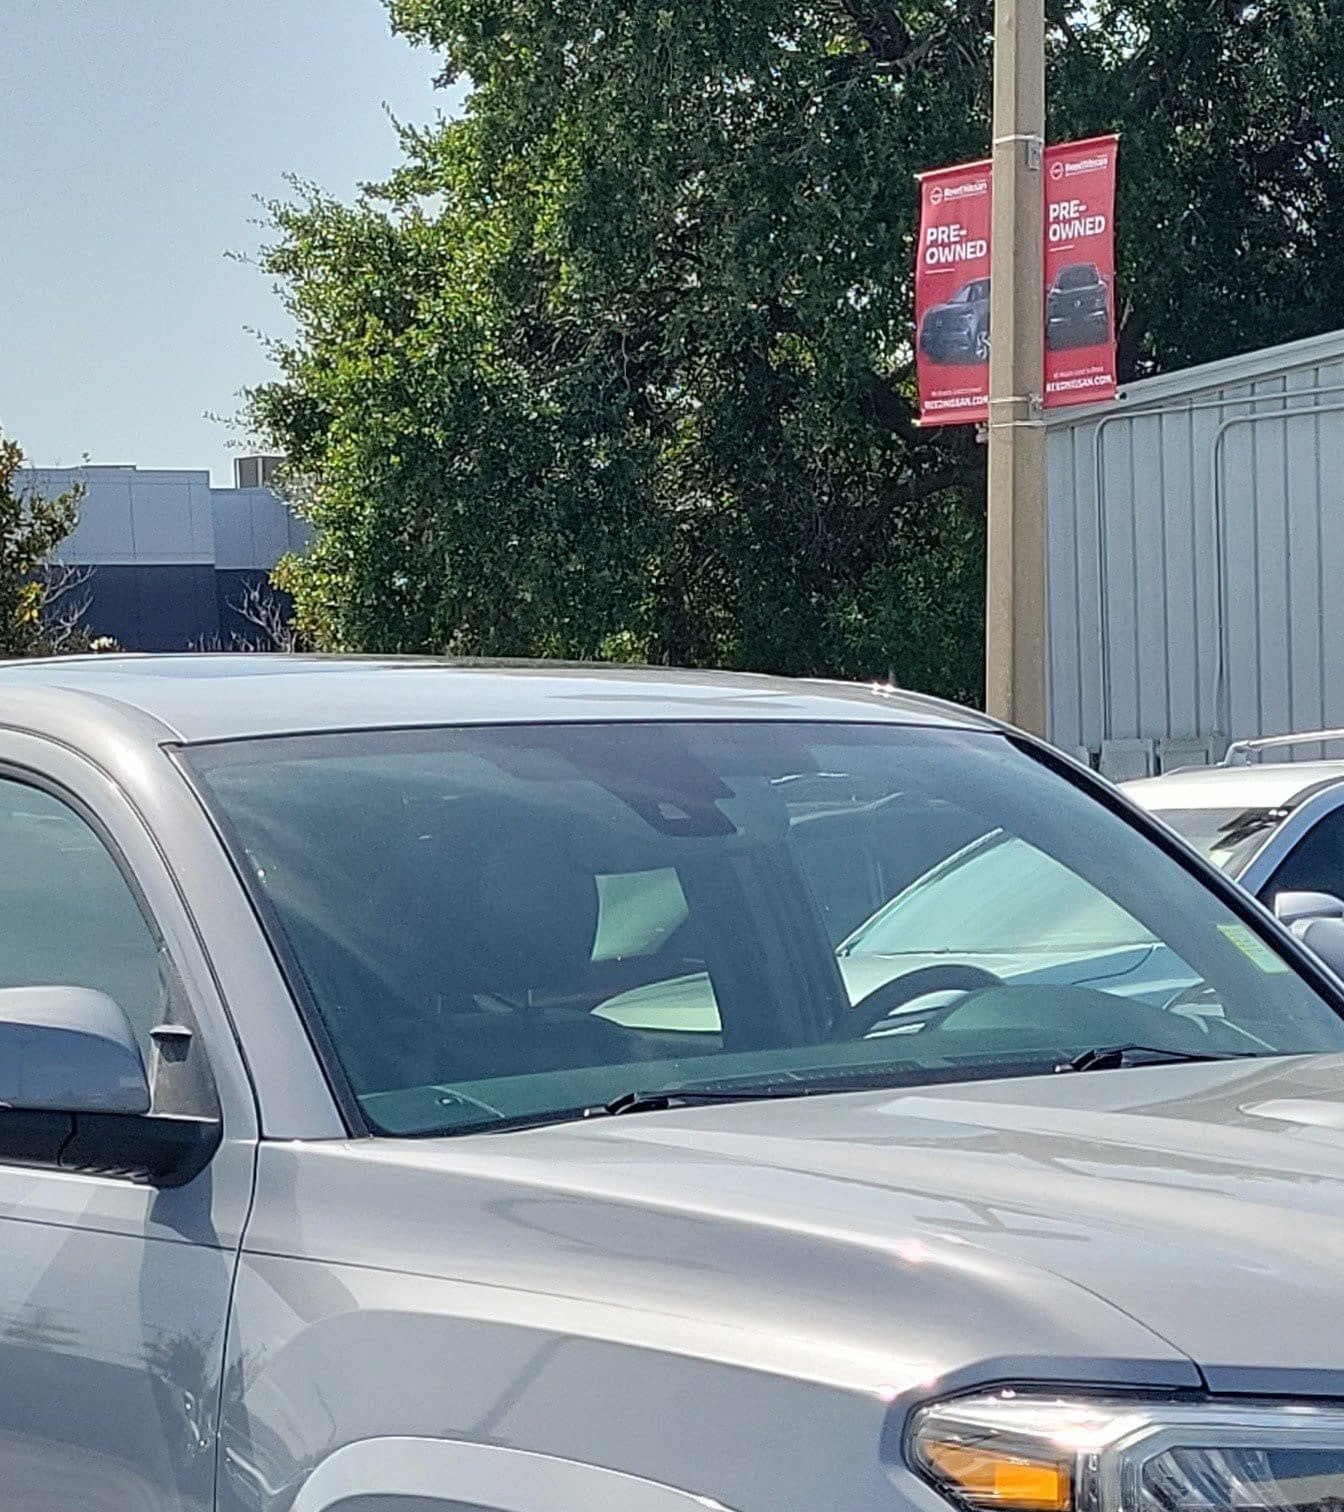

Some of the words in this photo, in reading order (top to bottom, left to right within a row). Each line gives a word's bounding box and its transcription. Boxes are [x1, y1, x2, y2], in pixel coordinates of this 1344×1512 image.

[1050, 200, 1087, 222] PRE-
[926, 224, 967, 245] PRE-
[1049, 216, 1105, 241] OWNED
[926, 240, 987, 264] OWNED
